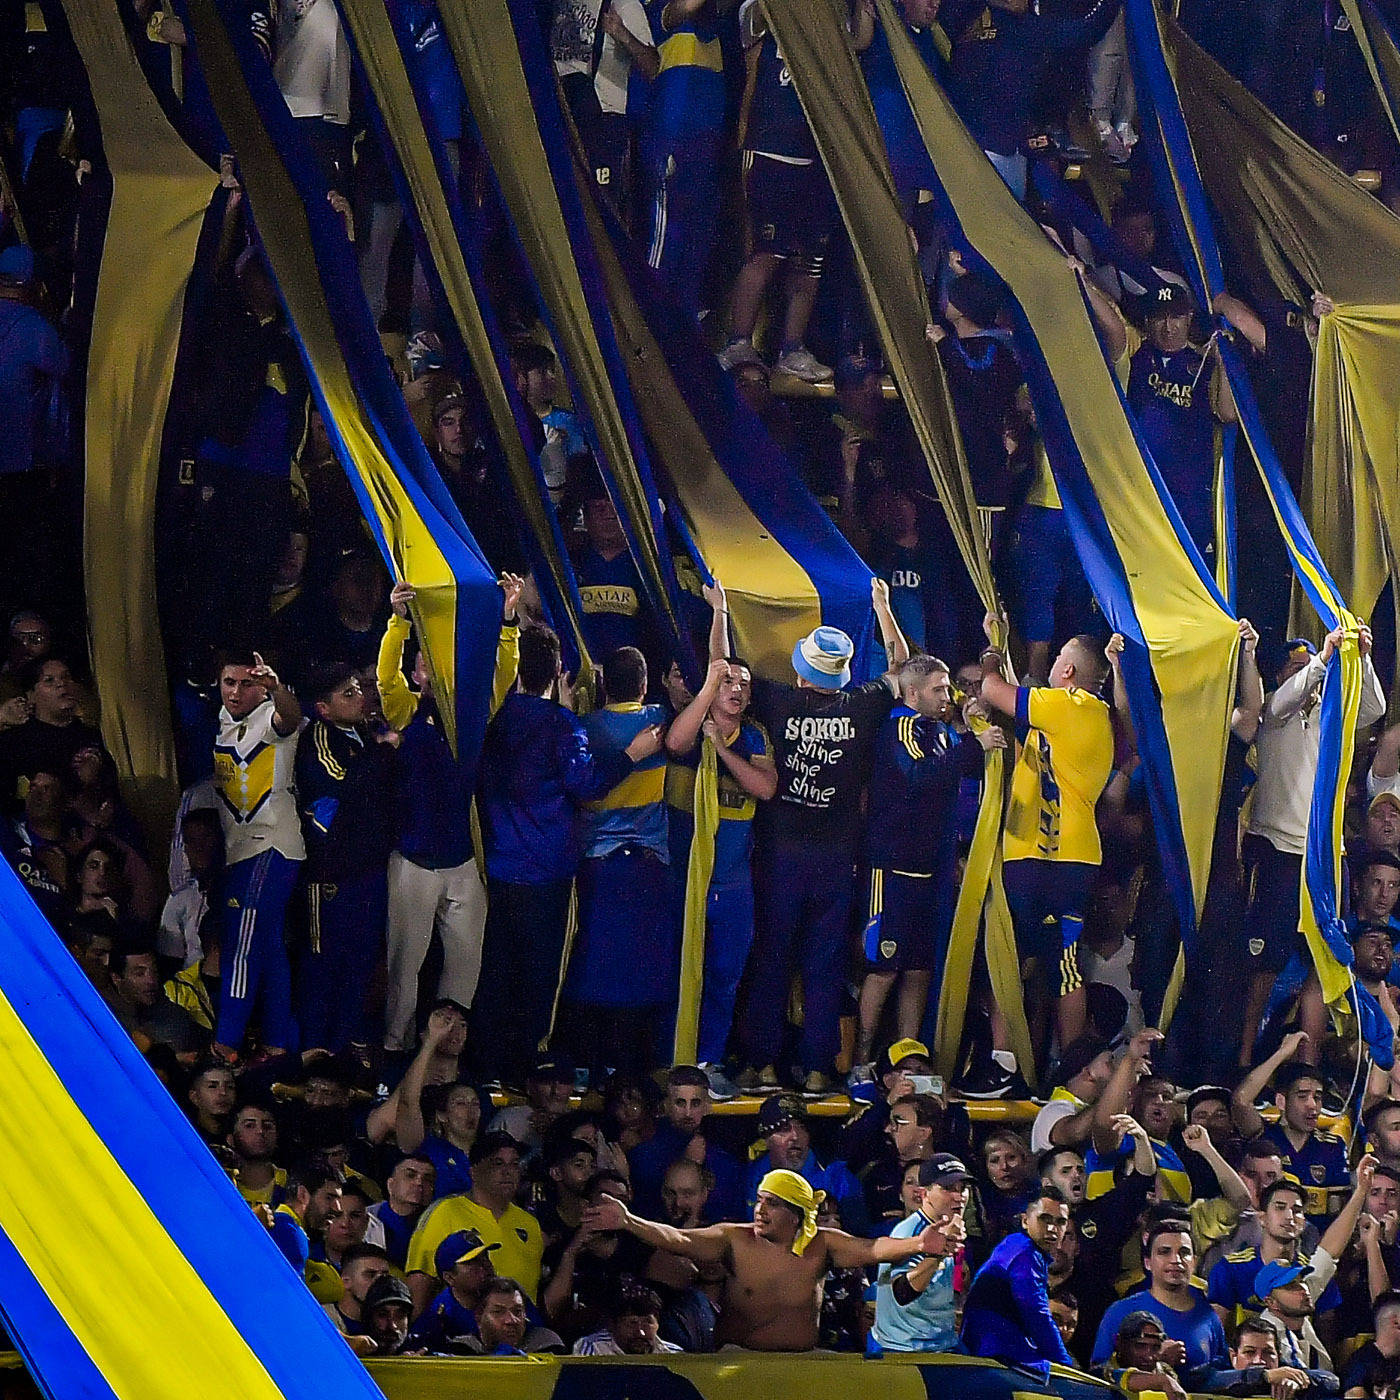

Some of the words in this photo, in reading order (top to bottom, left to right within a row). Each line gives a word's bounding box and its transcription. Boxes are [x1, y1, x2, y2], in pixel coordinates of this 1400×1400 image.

[581, 589, 631, 604] QATAR
[785, 716, 855, 742] SOKOL
[797, 737, 843, 766] shine
[790, 775, 836, 803] shine
